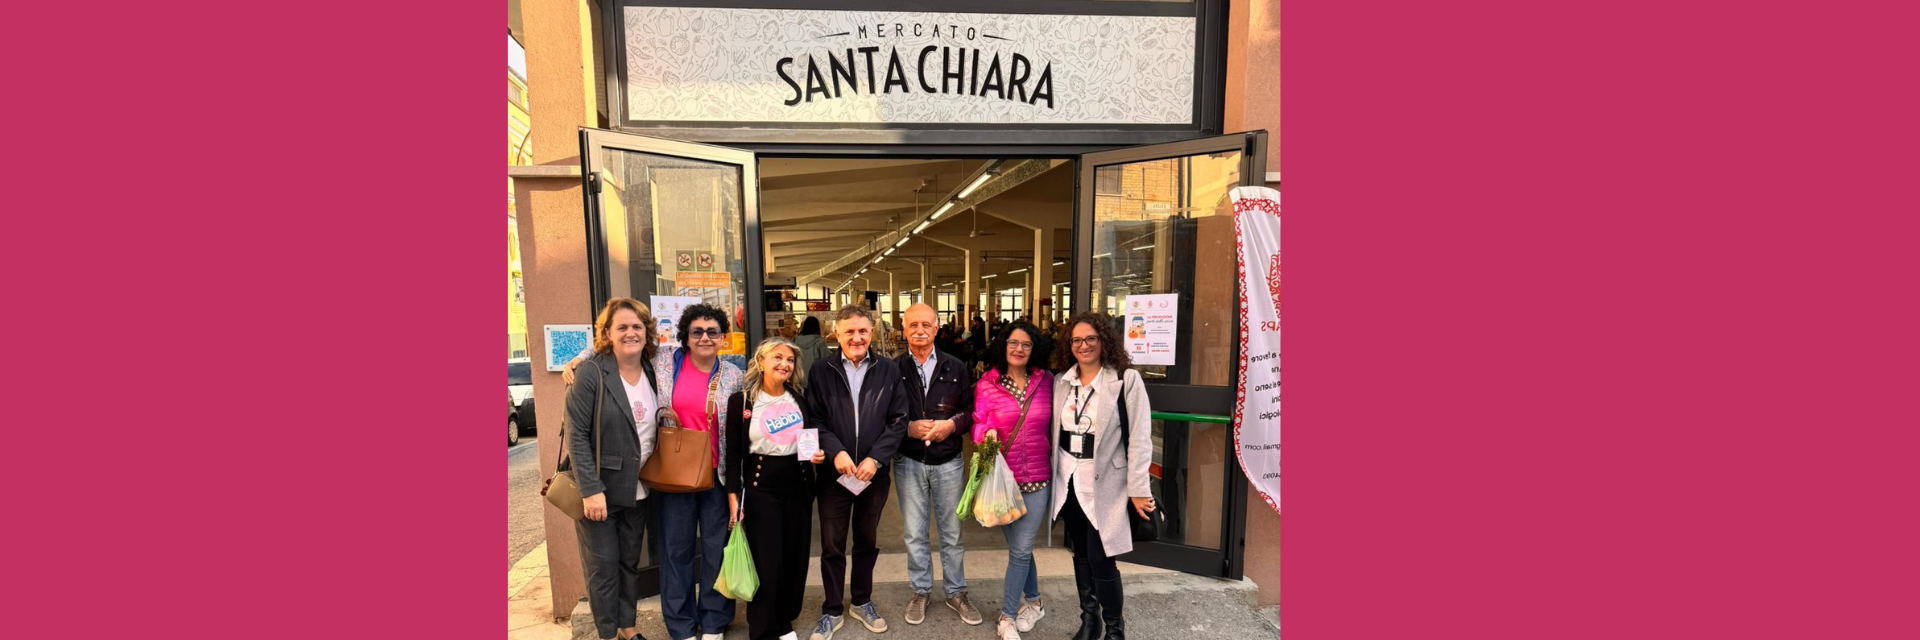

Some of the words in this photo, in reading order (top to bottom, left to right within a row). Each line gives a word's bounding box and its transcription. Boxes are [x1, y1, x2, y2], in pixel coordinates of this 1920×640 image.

[857, 23, 976, 41] MERCATO
[775, 45, 910, 107] SANTA
[916, 45, 1054, 109] CHIARA
[764, 411, 803, 434] Habibi
